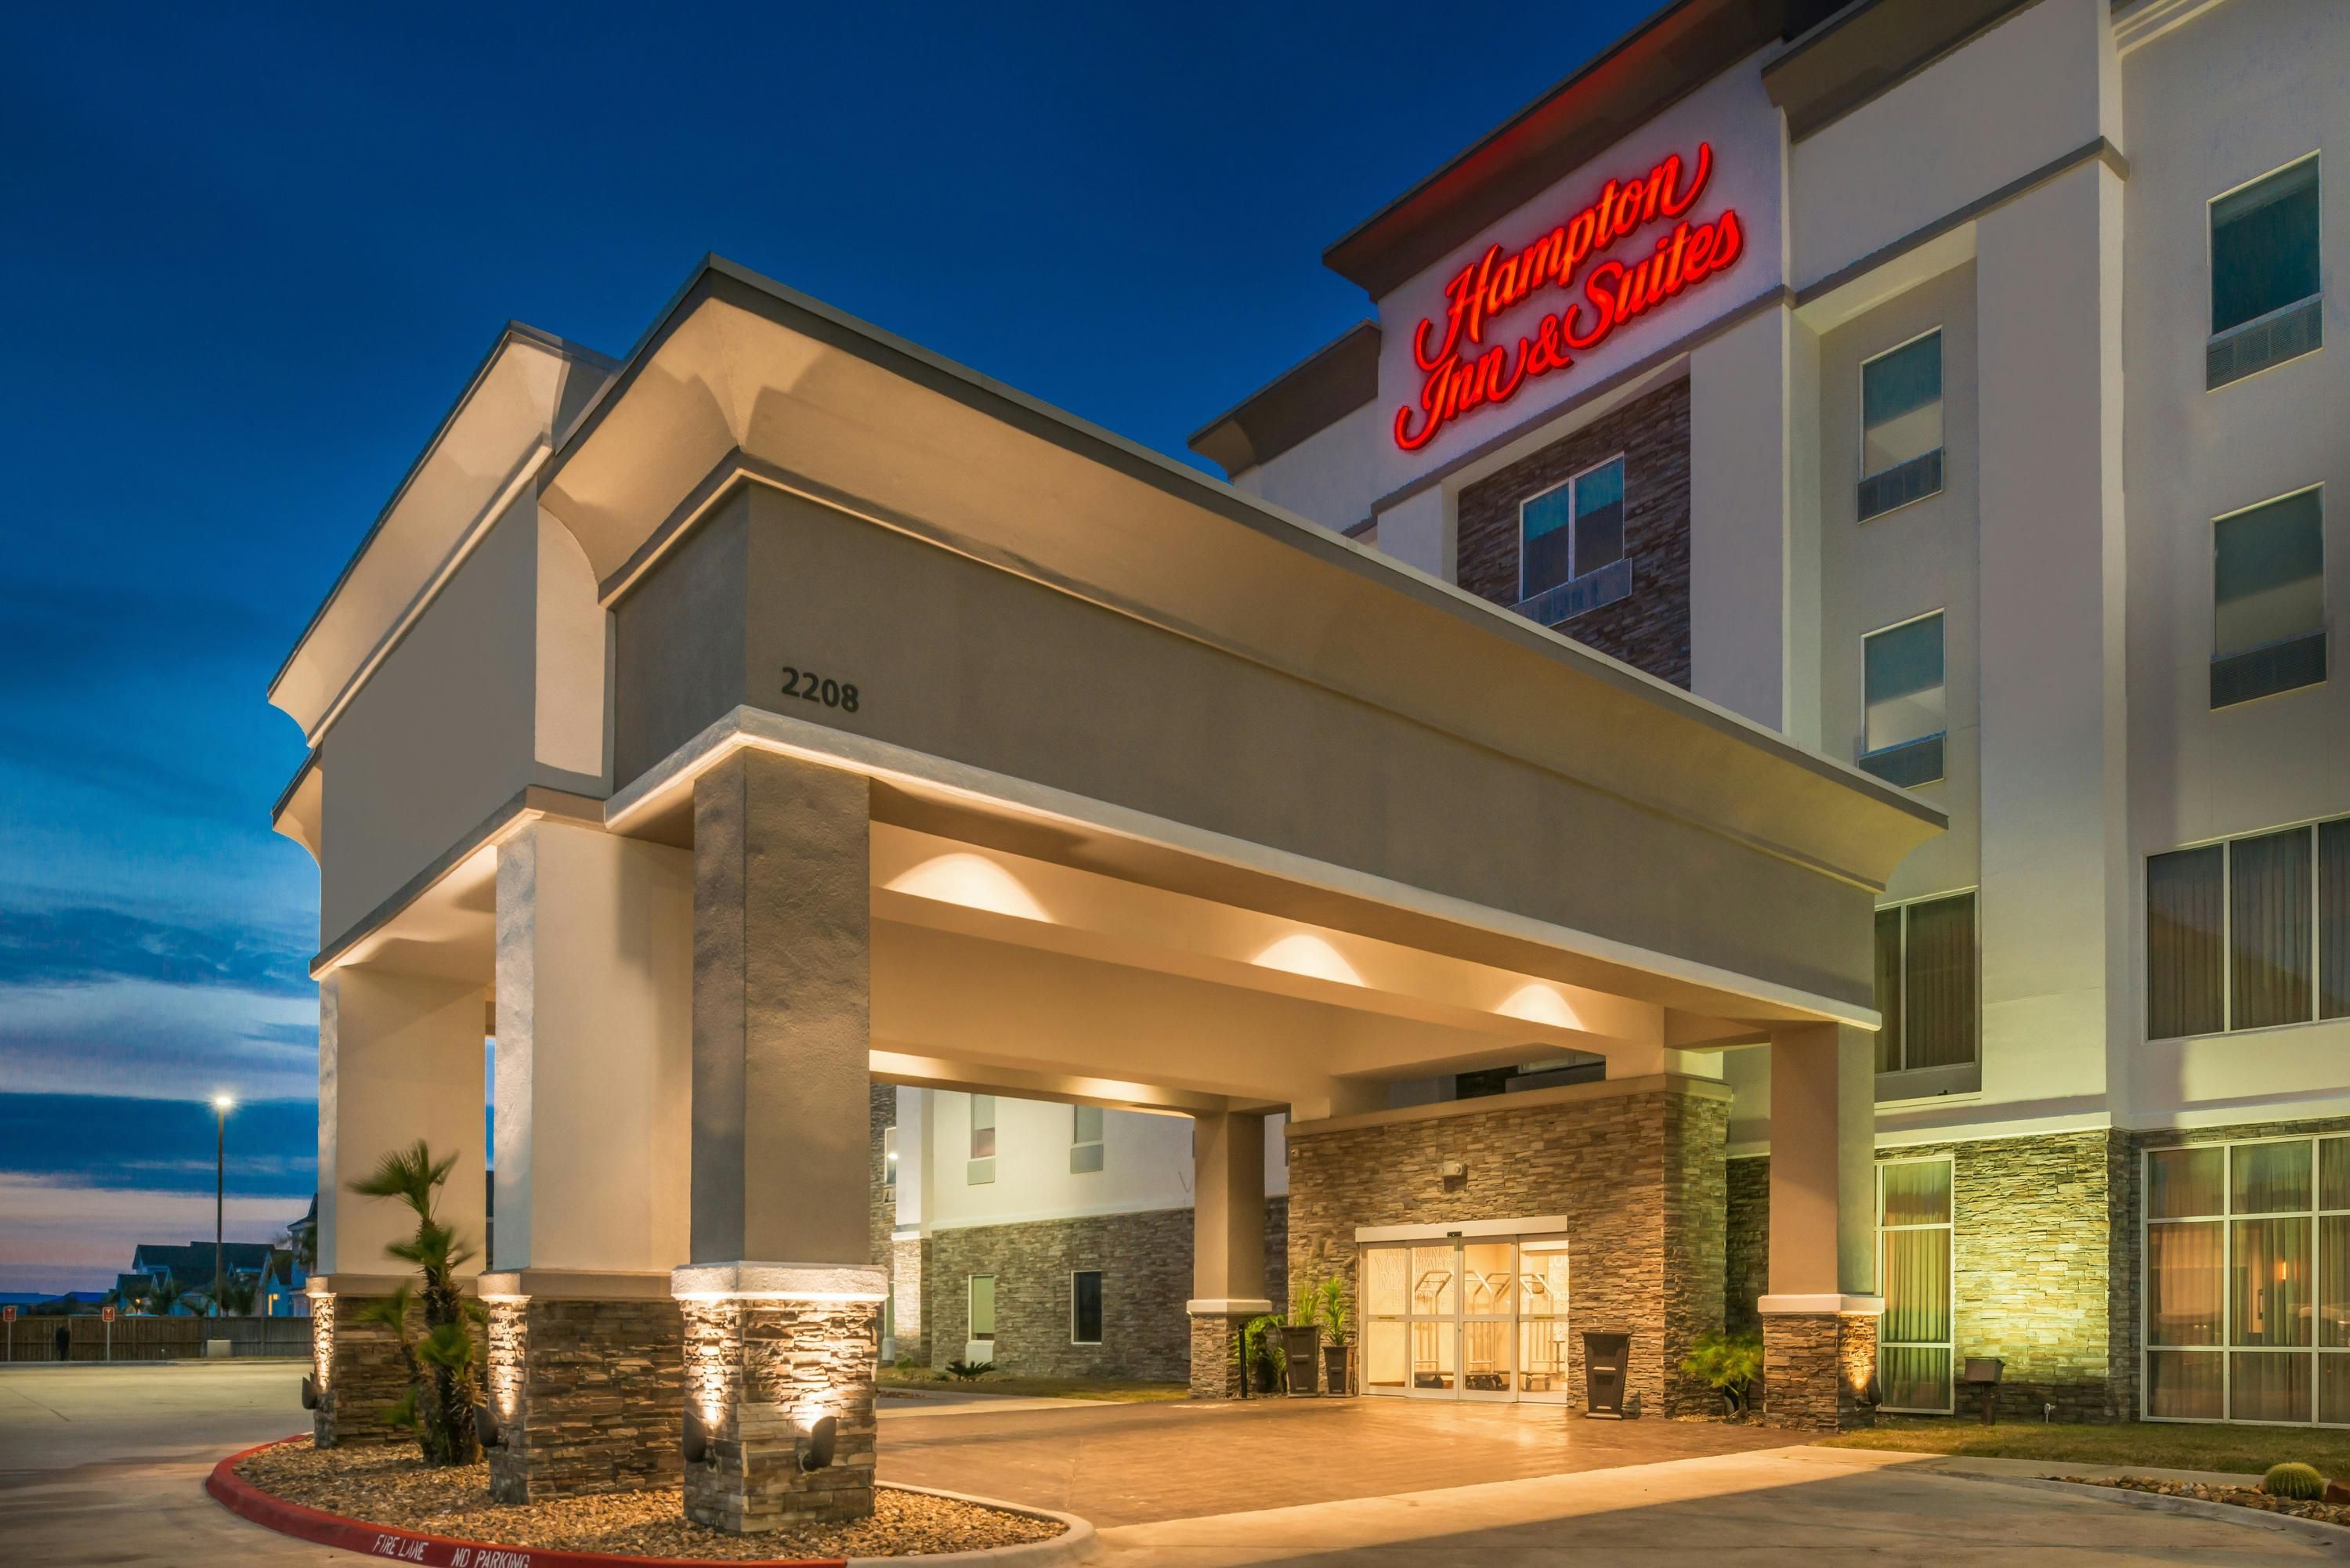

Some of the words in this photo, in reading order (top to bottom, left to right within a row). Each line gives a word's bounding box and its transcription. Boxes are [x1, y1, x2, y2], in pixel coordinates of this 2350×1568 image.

[1415, 143, 1712, 371] Hampton
[1394, 338, 1528, 452] Inn
[1527, 314, 1574, 376] &
[1564, 209, 1744, 350] Suites
[782, 667, 859, 713] 2208
[372, 1534, 400, 1555] FIRE
[398, 1539, 428, 1561] LANE
[450, 1548, 471, 1567] NO
[473, 1549, 530, 1568] PARKING
